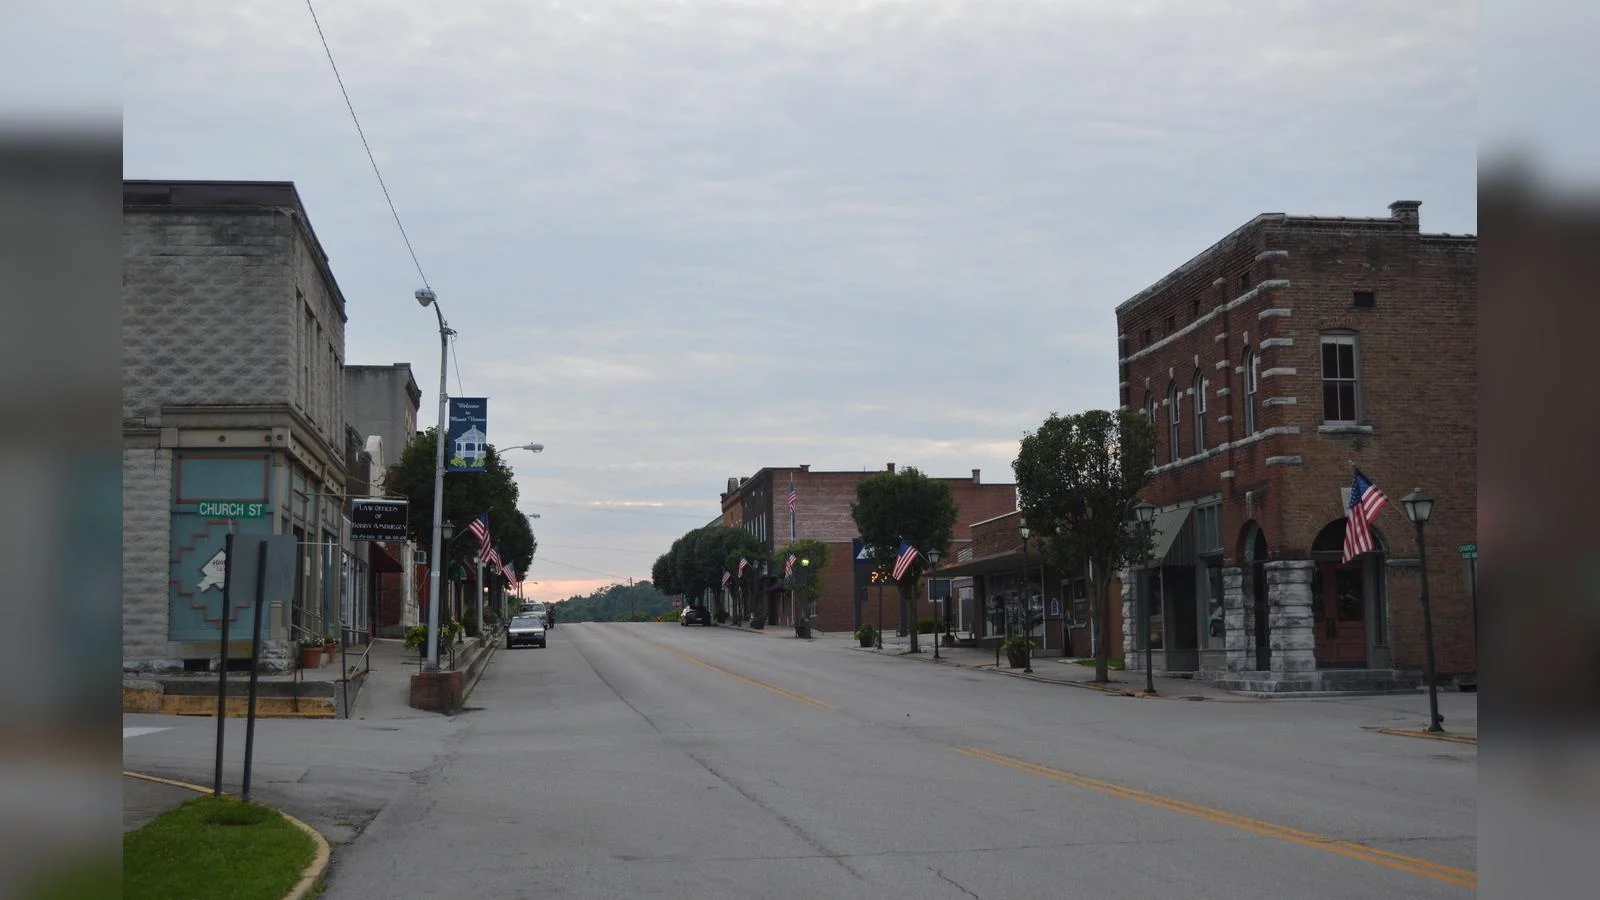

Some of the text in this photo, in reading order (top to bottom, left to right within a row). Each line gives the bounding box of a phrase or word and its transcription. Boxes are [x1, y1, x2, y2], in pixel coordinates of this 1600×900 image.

[199, 502, 263, 516] CHURCH ST
[374, 504, 399, 512] OFFICES
